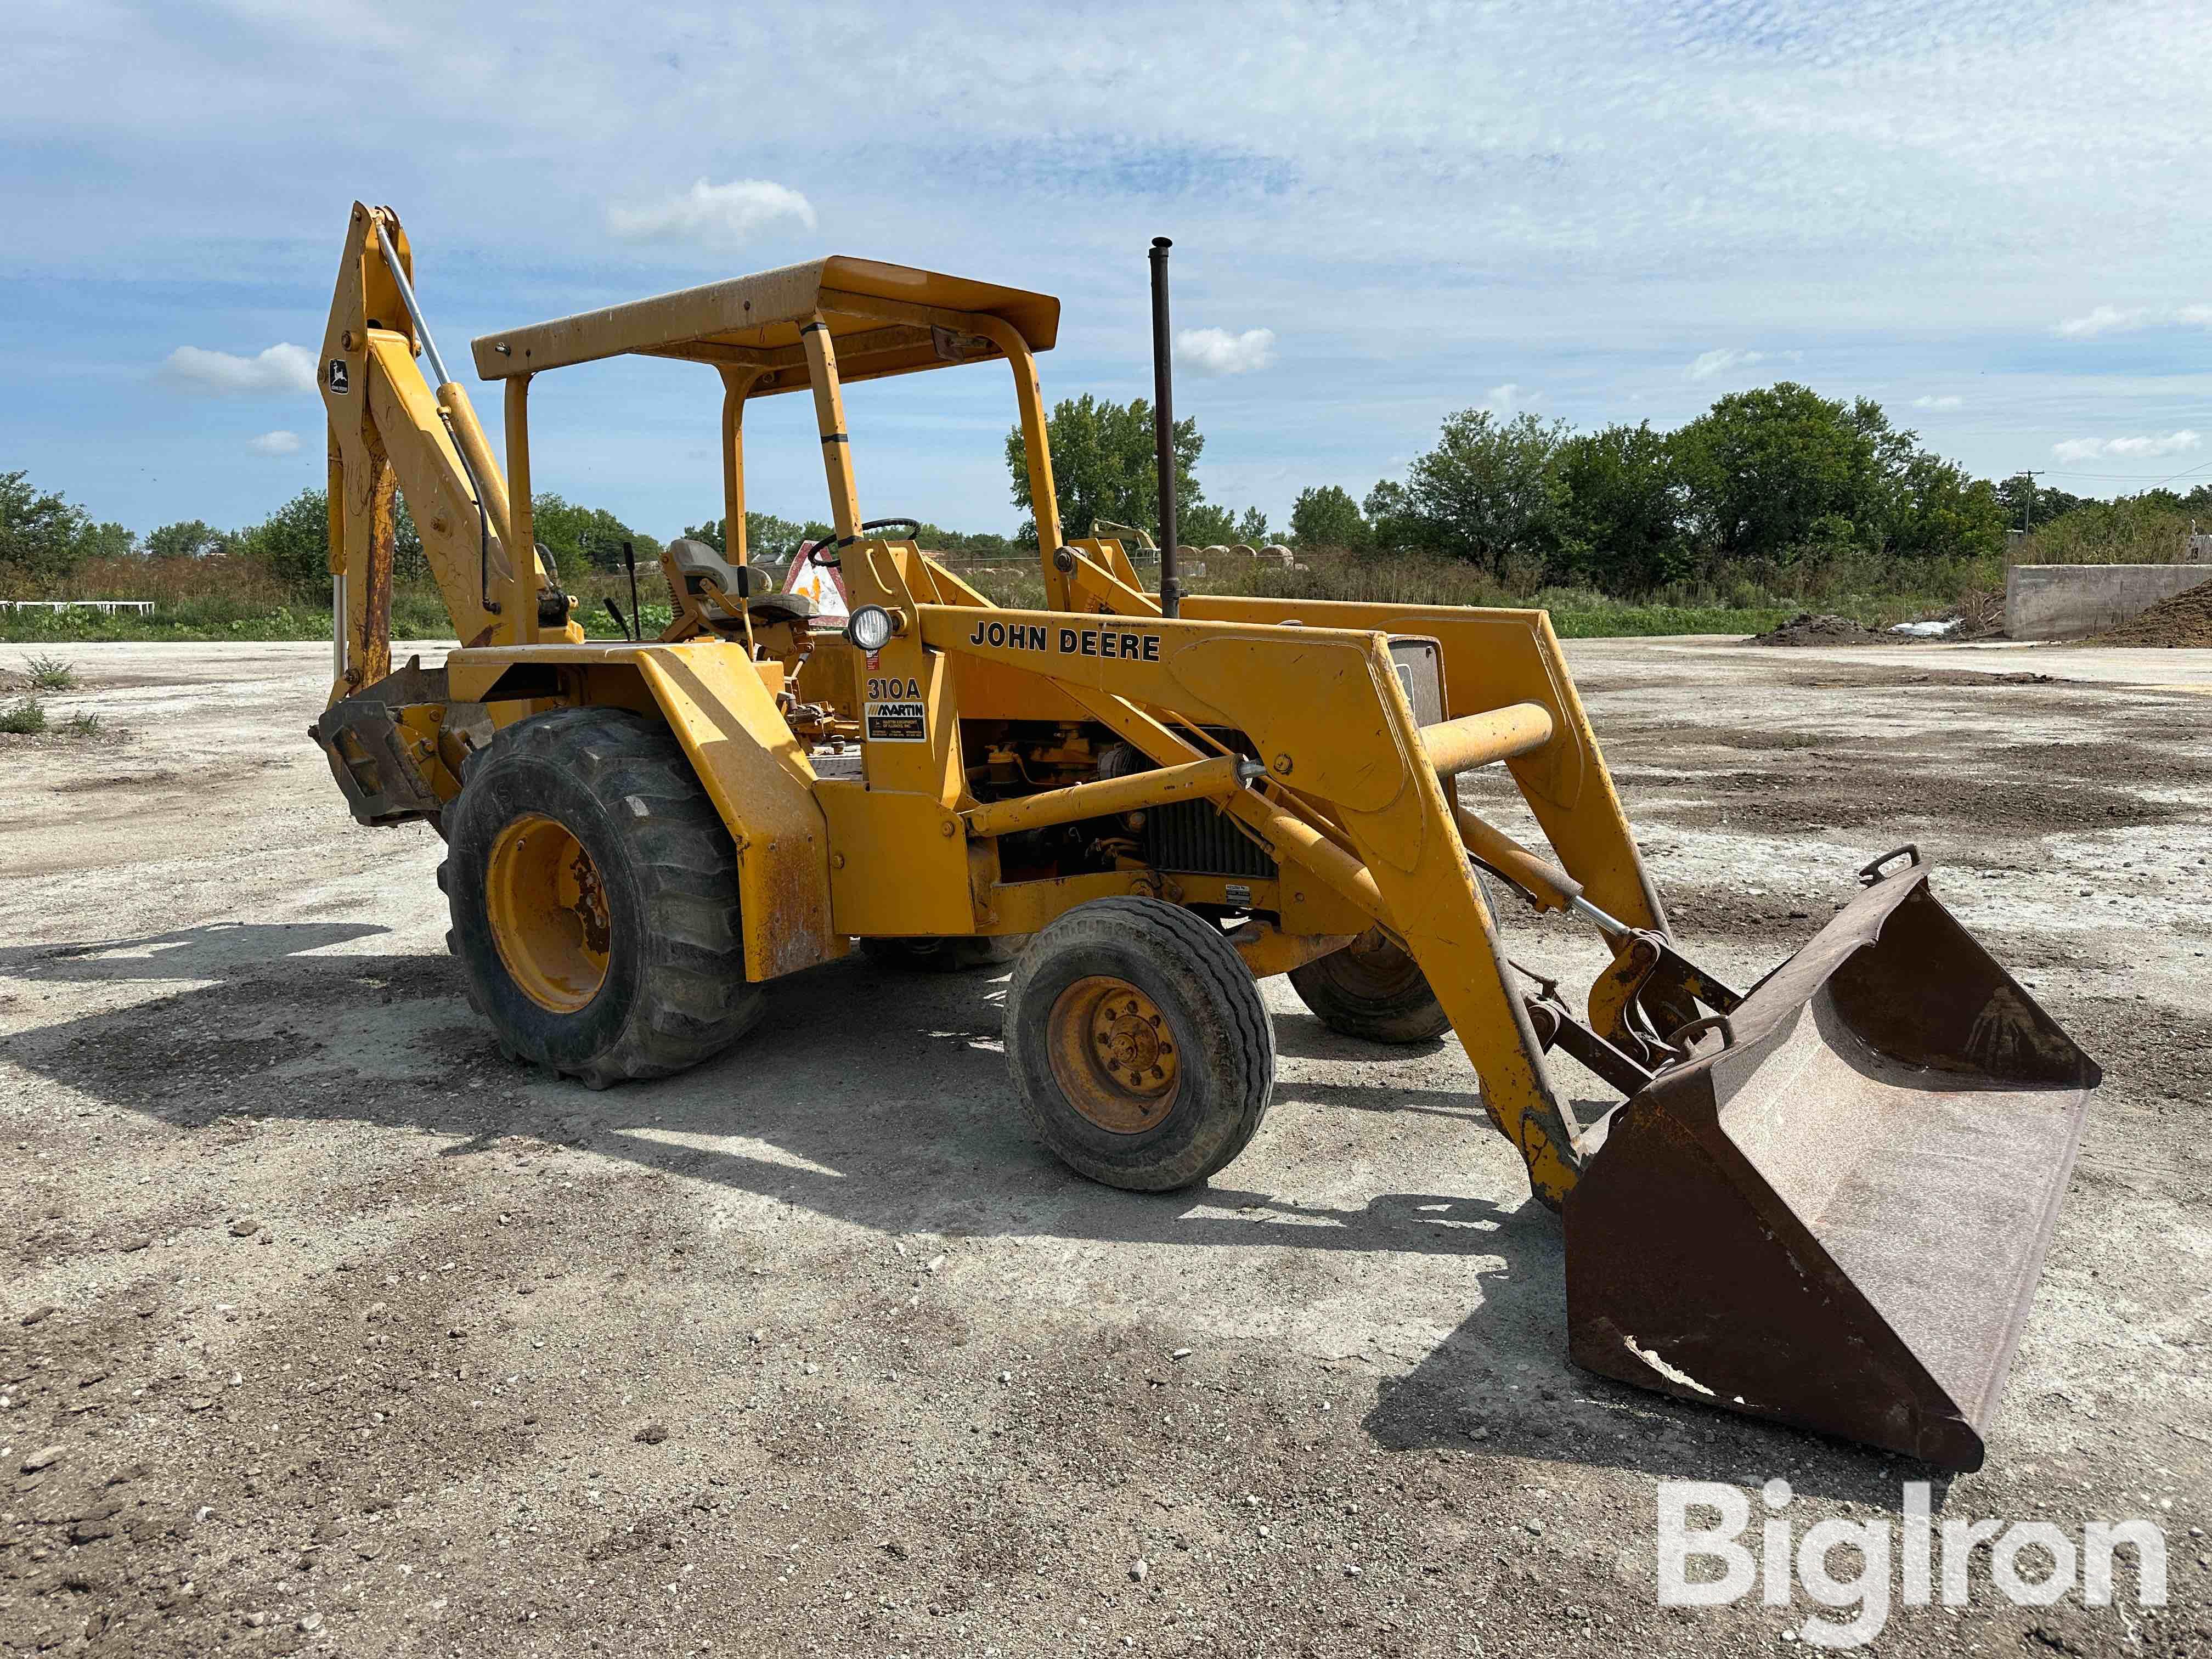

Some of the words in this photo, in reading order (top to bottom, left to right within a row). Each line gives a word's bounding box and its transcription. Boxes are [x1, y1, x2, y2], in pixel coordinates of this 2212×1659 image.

[969, 620, 1047, 653] JOHN
[1059, 628, 1161, 663] DEERE
[867, 678, 922, 700] 310A
[877, 704, 923, 716] MARTIN
